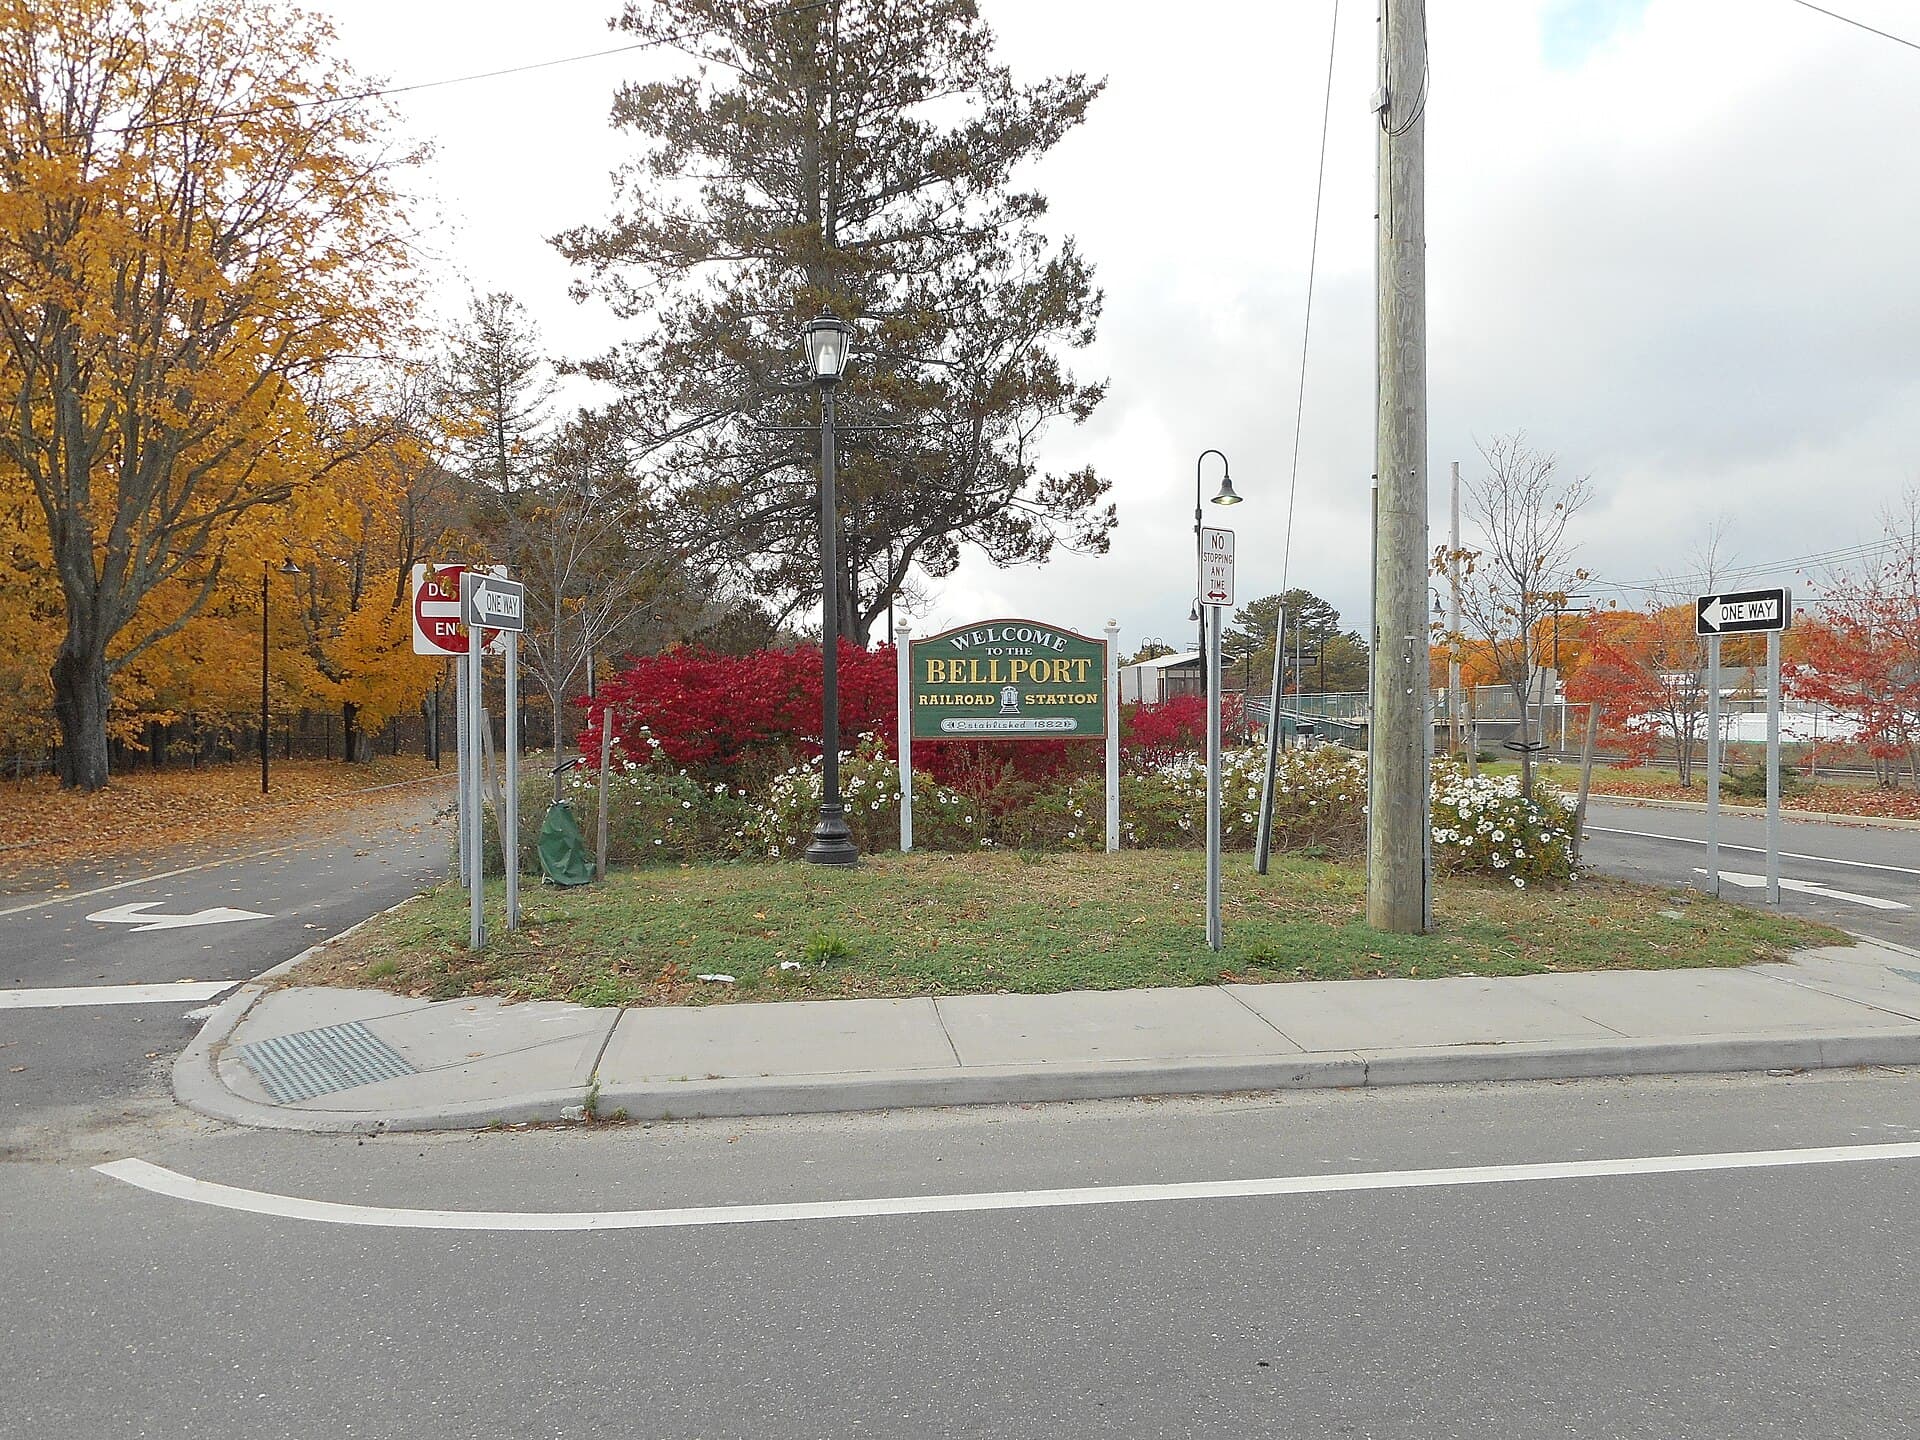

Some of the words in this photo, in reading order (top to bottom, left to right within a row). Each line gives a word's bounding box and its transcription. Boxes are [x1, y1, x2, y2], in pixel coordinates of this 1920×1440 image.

[1211, 535, 1224, 549] NO
[1203, 552, 1233, 564] STOPPING
[1211, 566, 1225, 576] ANY
[1210, 579, 1225, 590] TIME
[486, 592, 501, 612] ONE
[502, 595, 518, 615] WAY
[1721, 605, 1745, 621] ONE
[1748, 601, 1774, 619] WAY
[950, 627, 1068, 652] WELCOME
[985, 647, 1003, 656] TO
[1006, 647, 1033, 656] THE
[926, 658, 1092, 684] BELLPORT
[918, 694, 995, 705] RAILROAD
[1025, 693, 1098, 705] STATION
[957, 720, 1026, 730] Established
[1034, 720, 1062, 729] 1882
